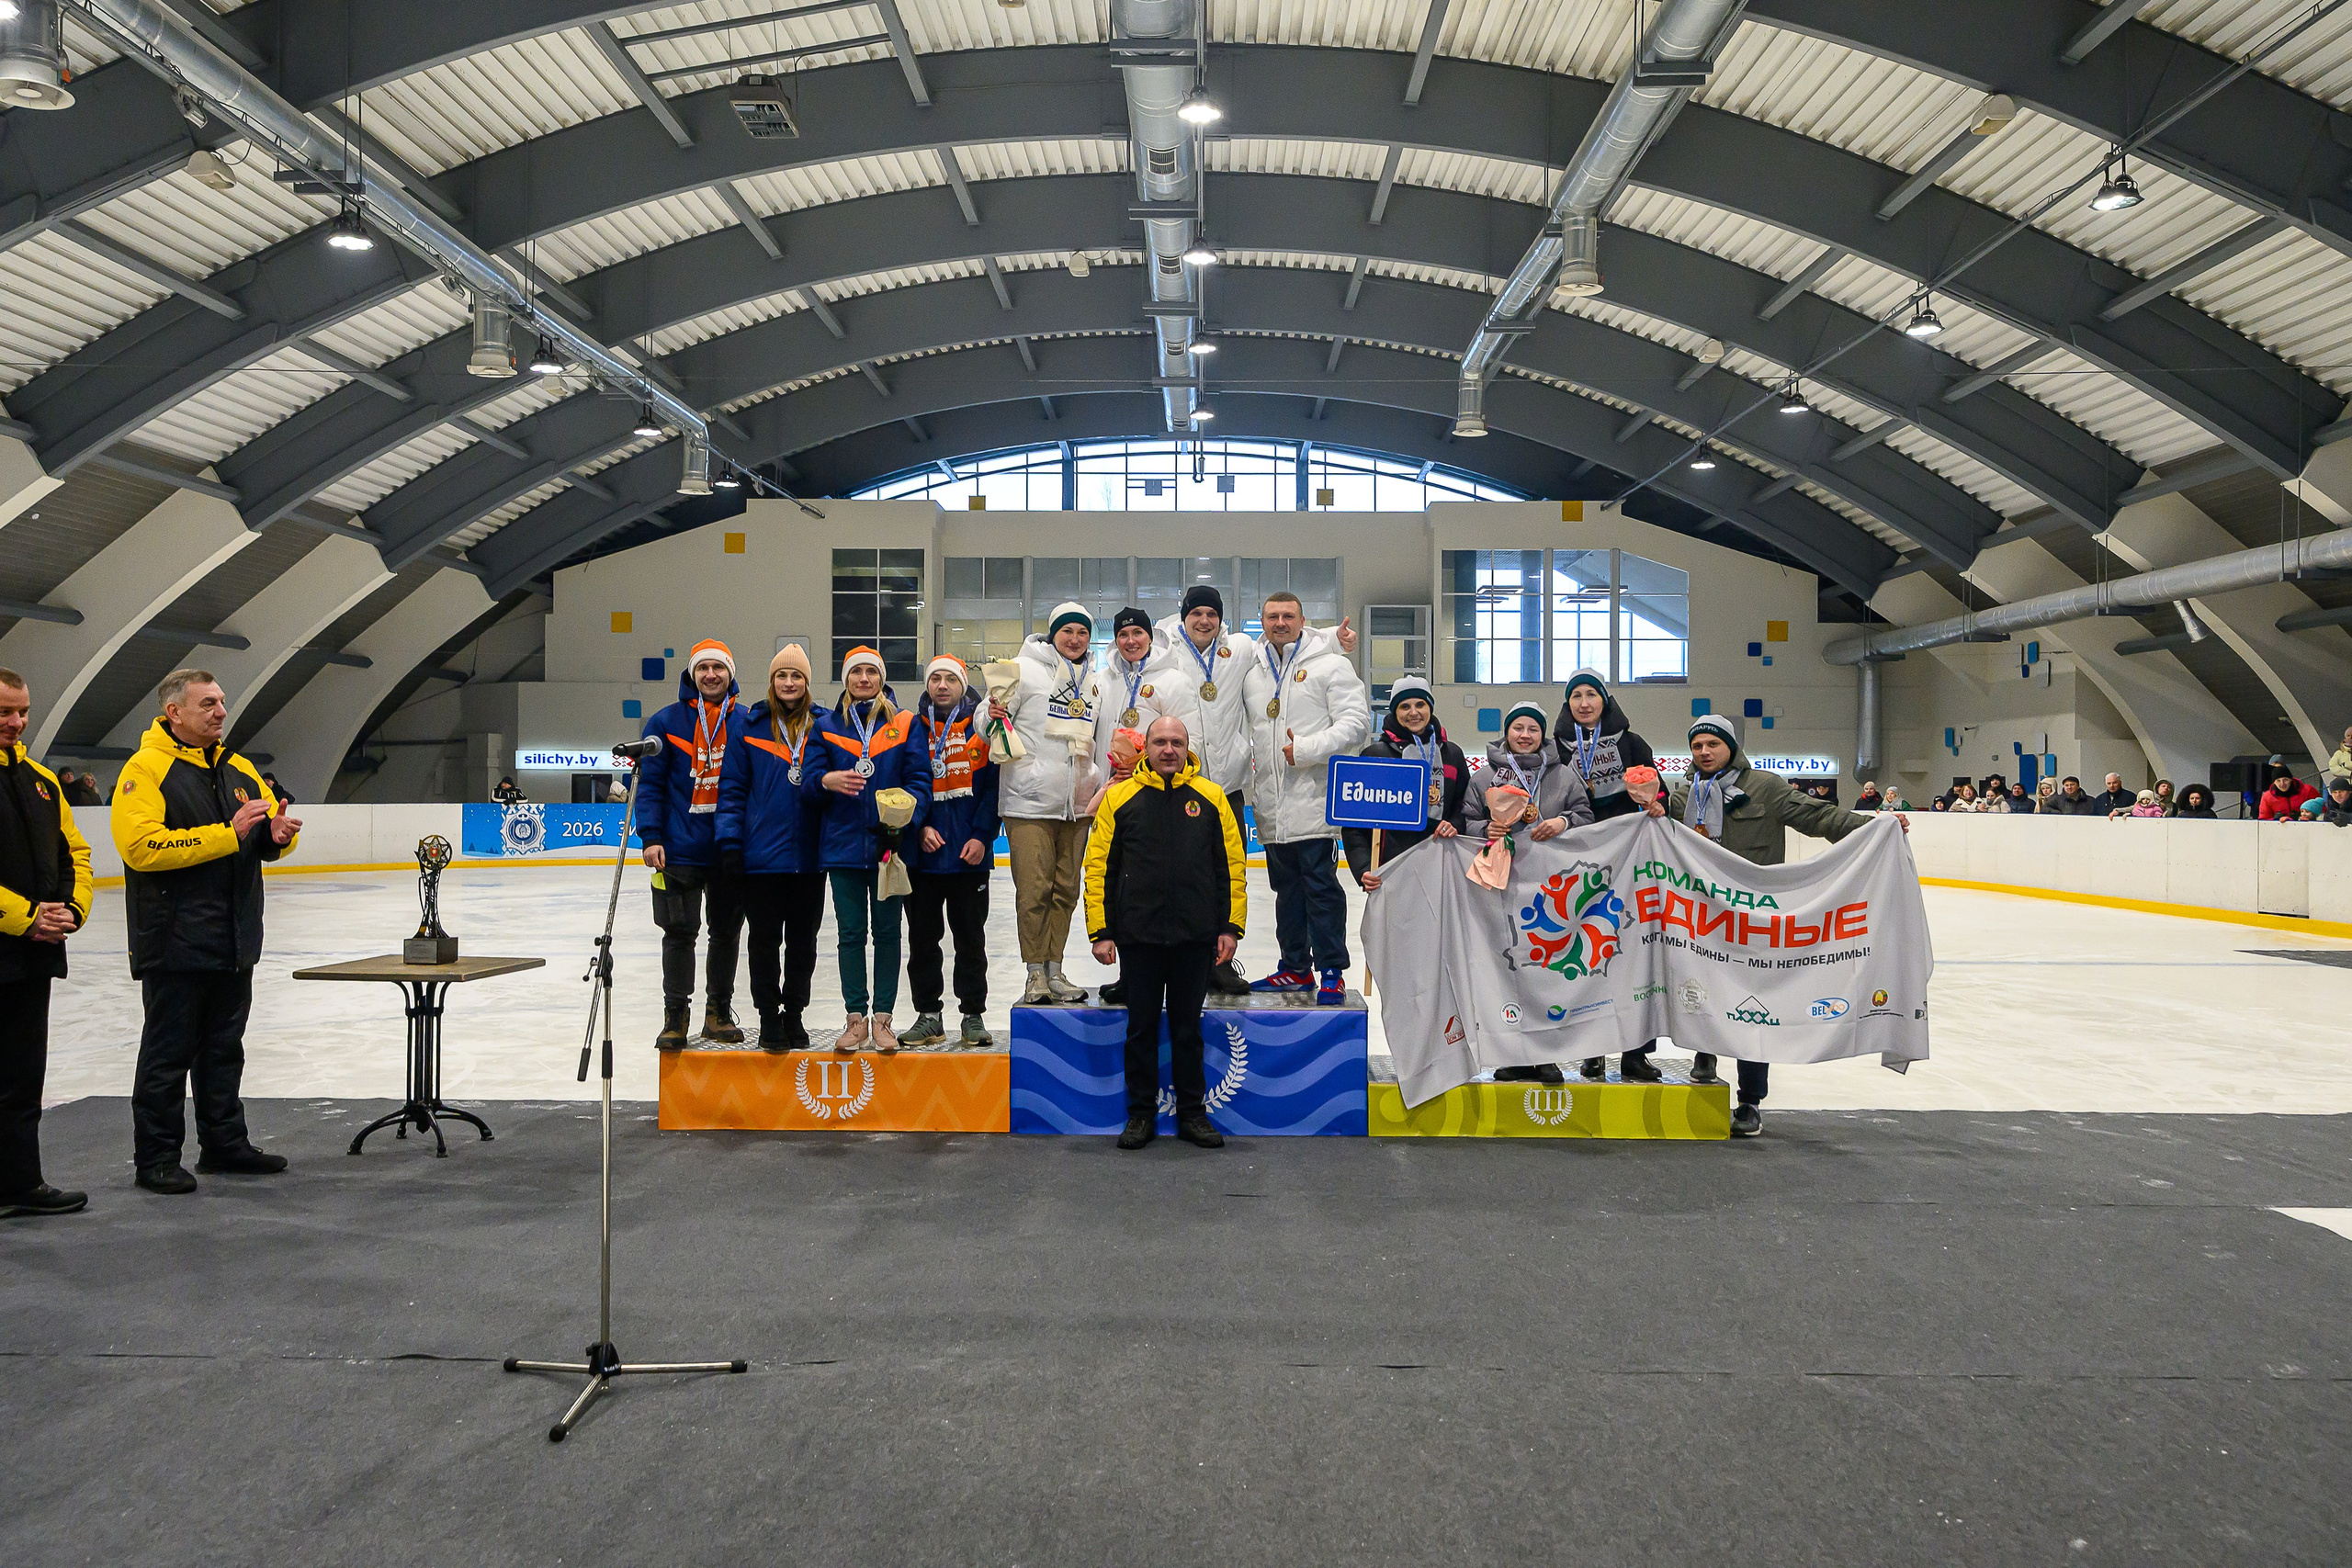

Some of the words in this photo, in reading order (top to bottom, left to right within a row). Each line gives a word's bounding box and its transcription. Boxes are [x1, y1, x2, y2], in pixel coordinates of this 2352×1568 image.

[525, 754, 598, 766] silichy.by
[1577, 751, 1617, 770] ЕИНЫЕ
[1754, 759, 1830, 772] silichy.by
[1342, 782, 1413, 805] Единые
[562, 822, 604, 837] 2026
[1634, 861, 1780, 909] КОМАНДА
[1635, 886, 1869, 949] ЕДИНЫЕ
[1665, 936, 1687, 948] МЫ
[1690, 943, 1729, 963] ЕДИНЫ
[1748, 958, 1772, 969] МЫ
[1777, 947, 1871, 969] НЕПОБЕДИМЫ!
[816, 1061, 854, 1099] II
[1532, 1089, 1565, 1111] III
